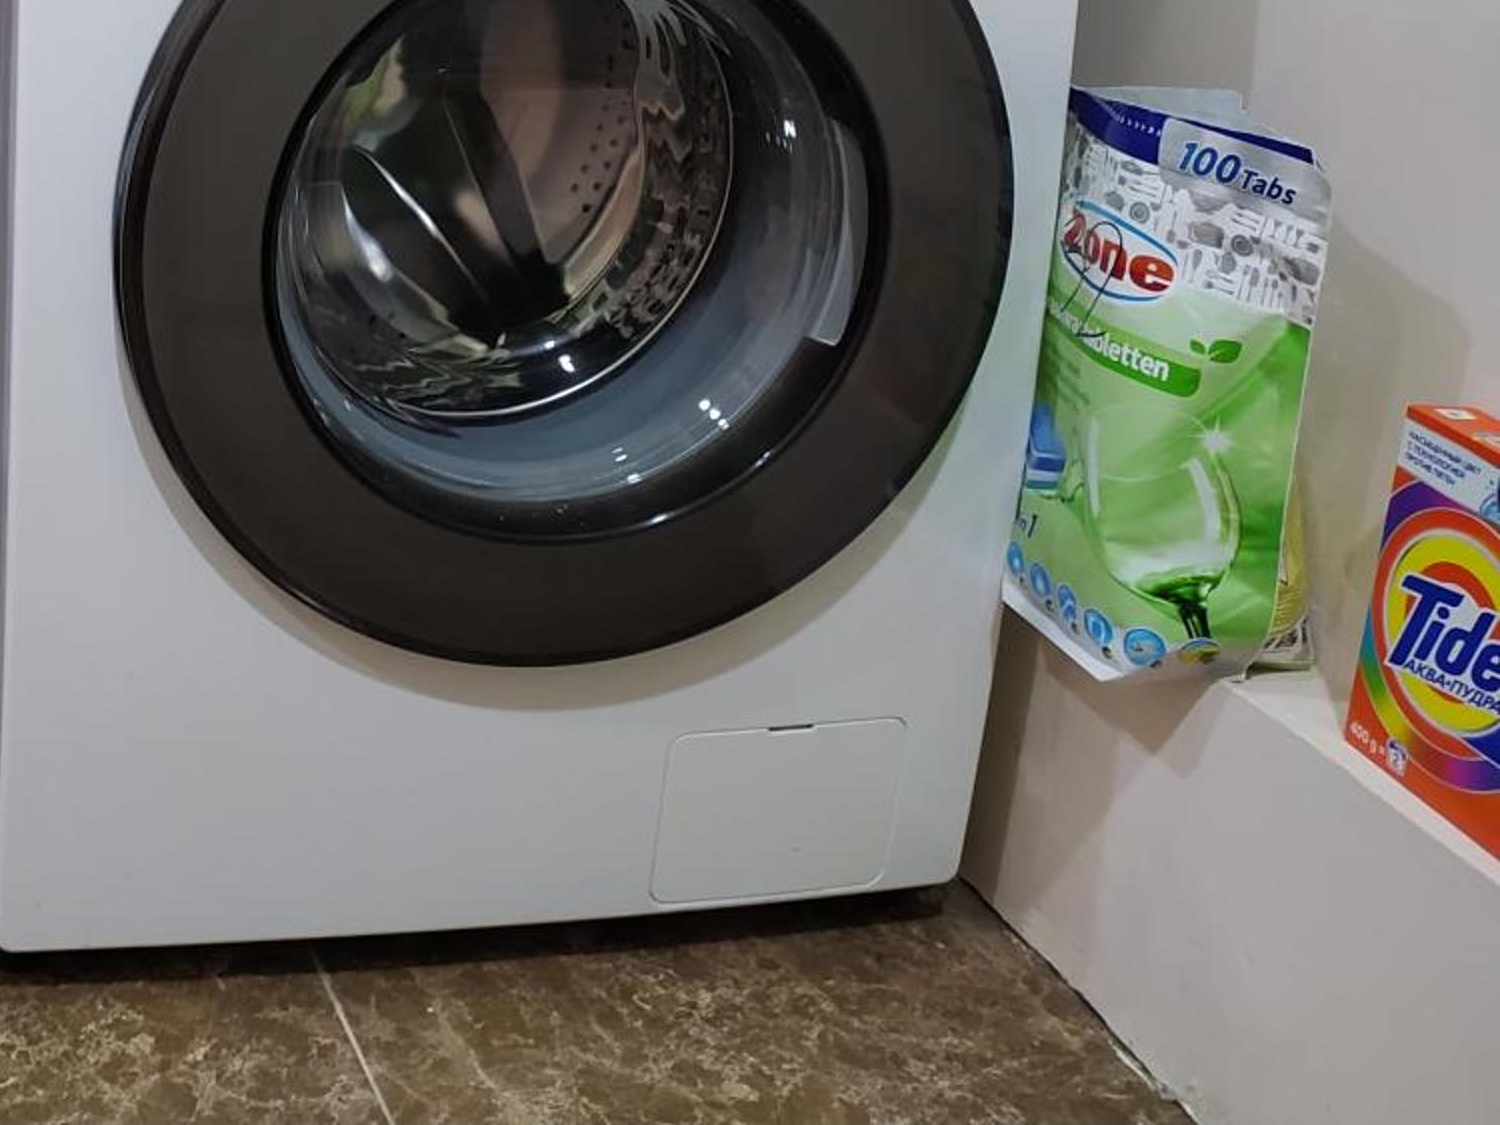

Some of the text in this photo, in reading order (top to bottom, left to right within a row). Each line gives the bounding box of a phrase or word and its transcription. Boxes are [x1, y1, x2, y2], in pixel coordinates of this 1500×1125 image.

[1178, 141, 1297, 206] 100 Tabs
[1389, 574, 1500, 693] Tide
